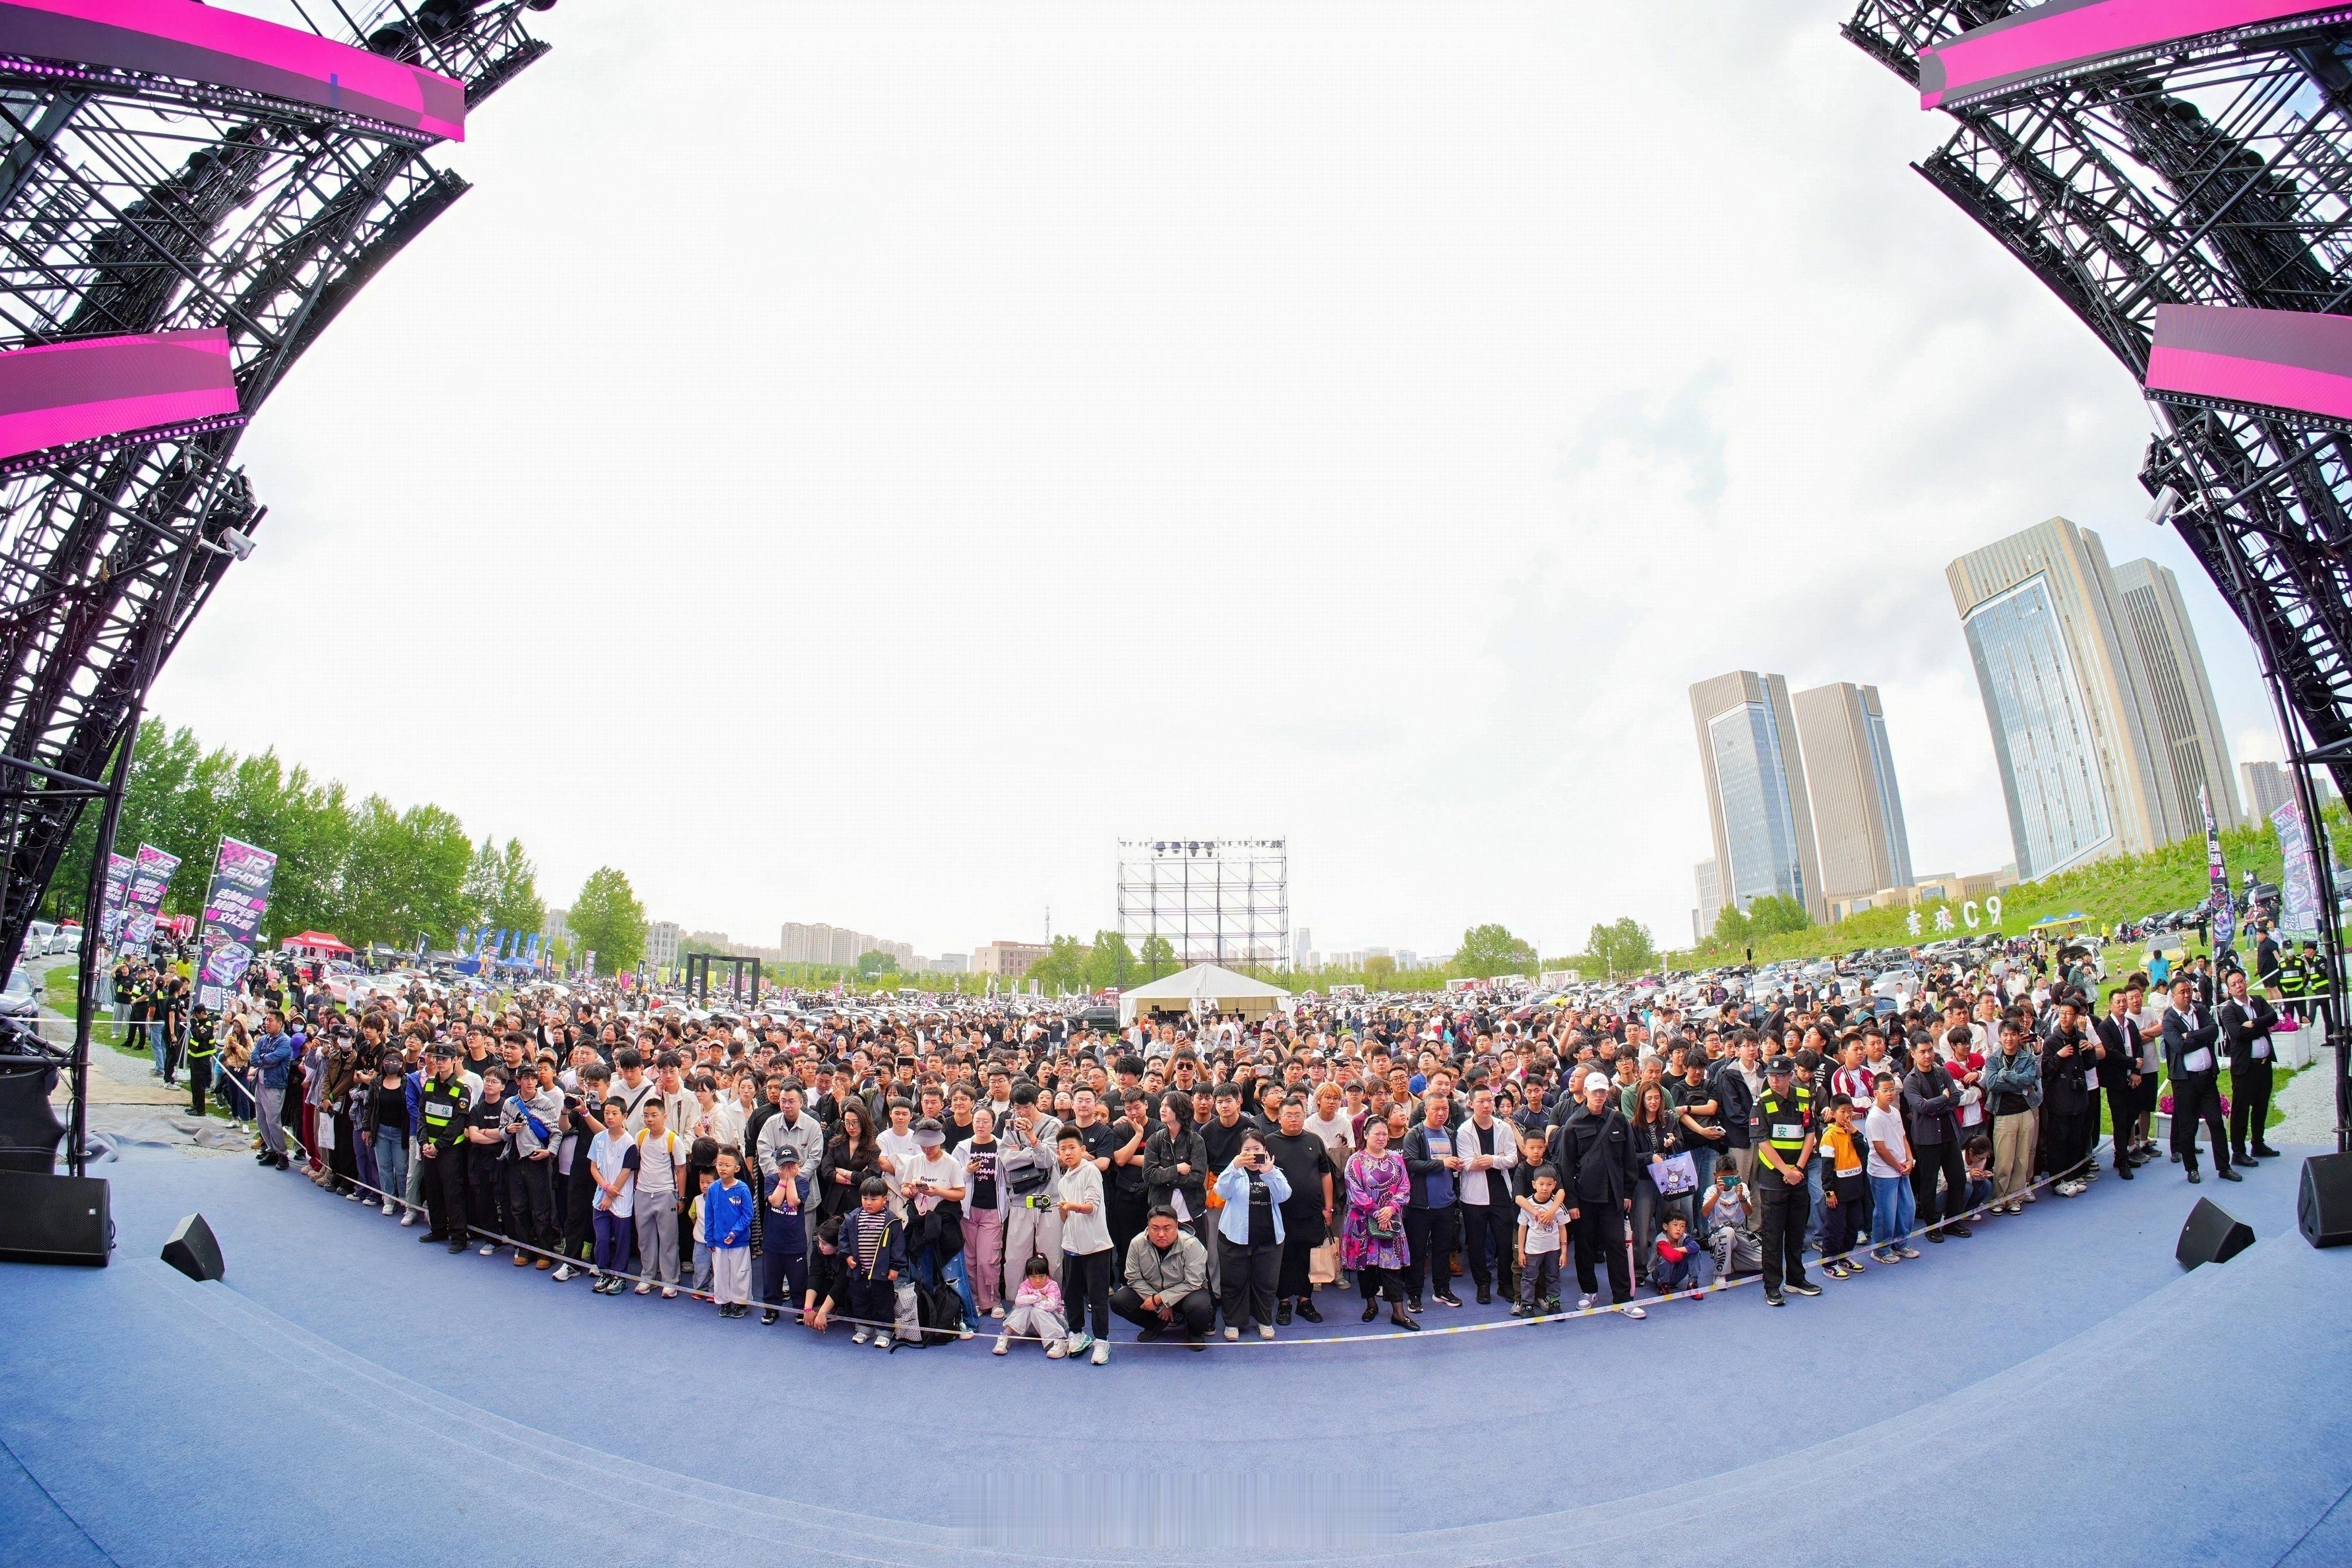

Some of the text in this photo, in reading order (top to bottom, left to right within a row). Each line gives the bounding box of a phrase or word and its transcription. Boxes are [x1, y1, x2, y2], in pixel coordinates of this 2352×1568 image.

[140, 864, 171, 878] SHOW
[147, 857, 176, 871] JR
[228, 854, 271, 876] JR
[223, 867, 269, 888] SHOW
[1963, 896, 2002, 928] C9
[427, 1104, 450, 1115] 安保
[1667, 1185, 1689, 1195] Kuromi
